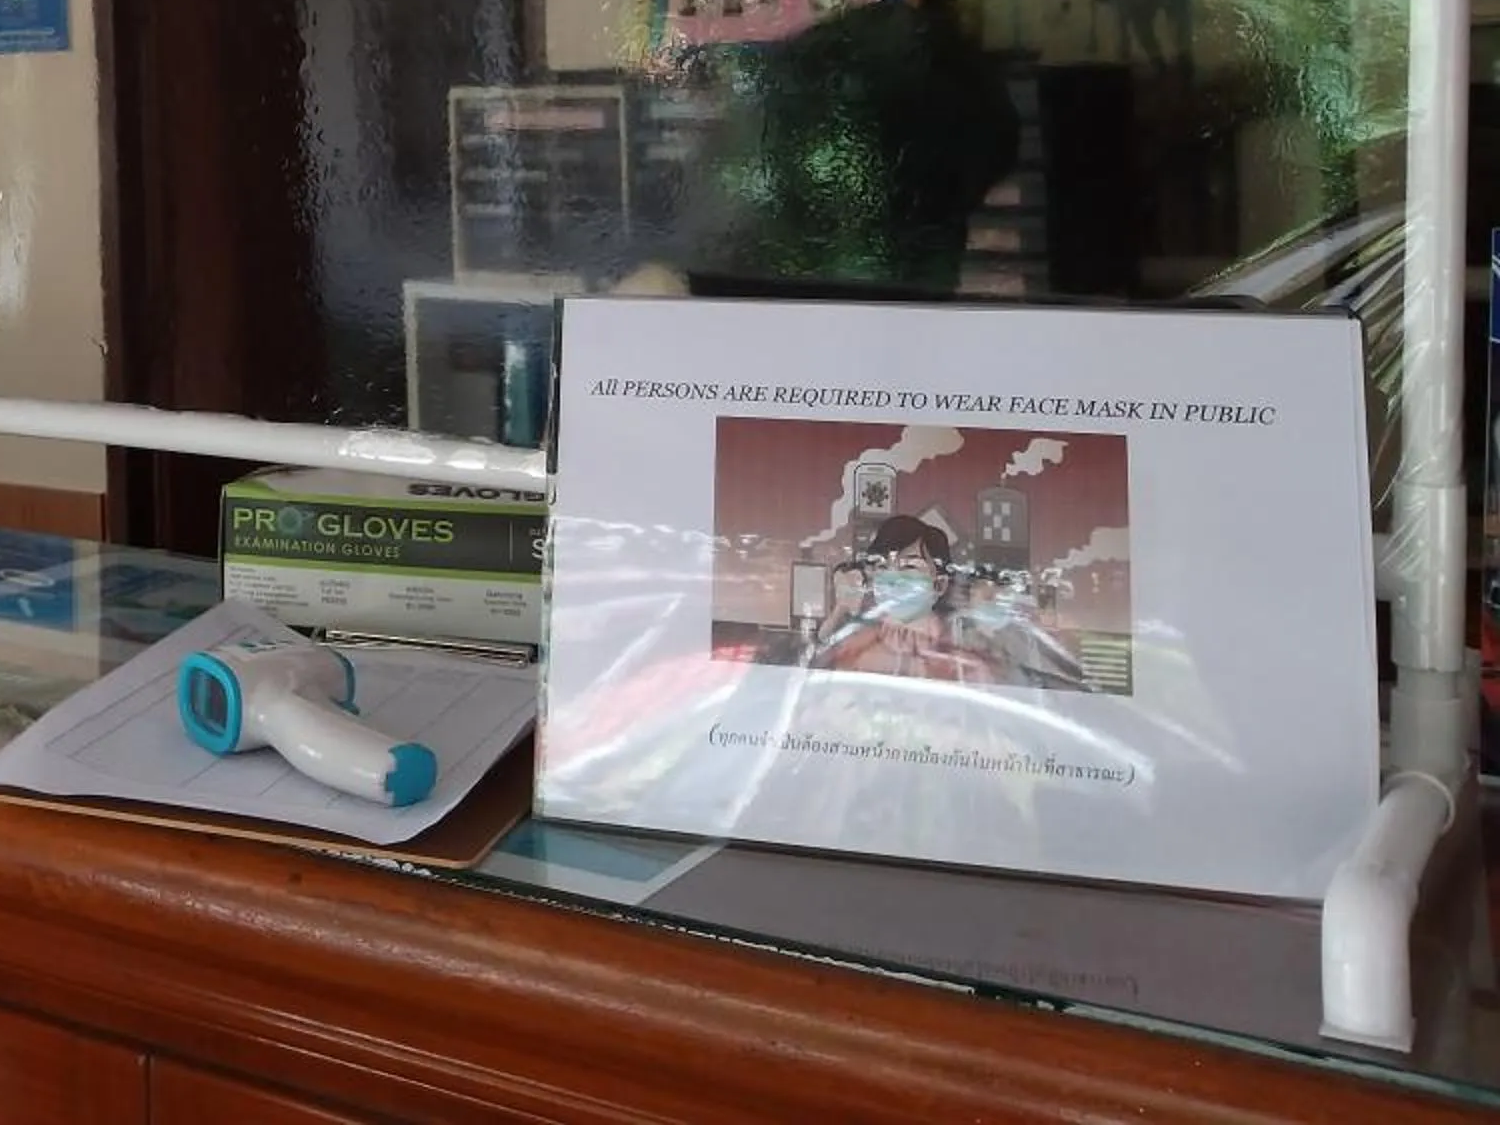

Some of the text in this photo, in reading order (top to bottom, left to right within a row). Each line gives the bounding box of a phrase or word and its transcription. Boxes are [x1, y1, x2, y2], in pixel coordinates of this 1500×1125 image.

[591, 379, 1278, 425] All PERSONS ARE REQUIRED TO WEAR FACE MASK IN PUBLIC
[408, 483, 546, 503] GLOVES
[317, 513, 455, 543] GLOVES
[234, 534, 400, 559] EXAMINATION GLOVES
